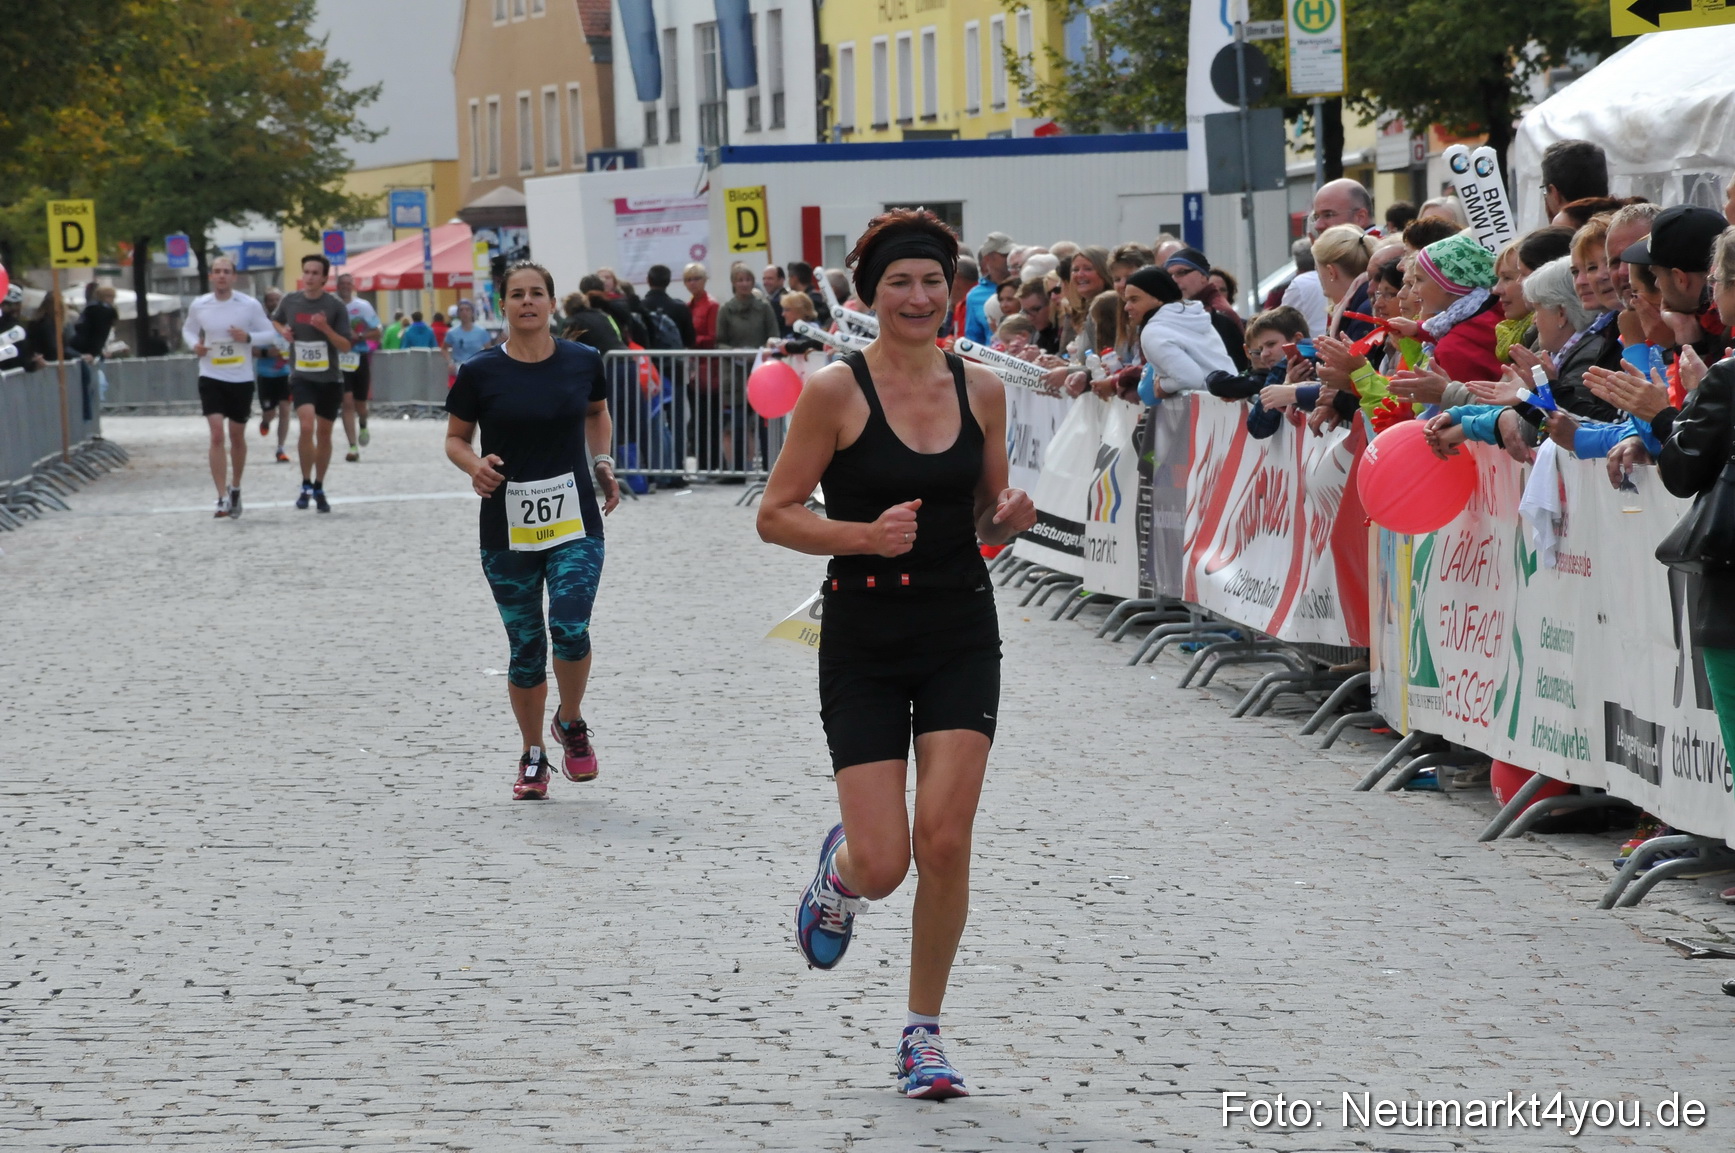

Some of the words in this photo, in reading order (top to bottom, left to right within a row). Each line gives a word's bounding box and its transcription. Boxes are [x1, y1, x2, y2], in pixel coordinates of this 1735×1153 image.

[53, 203, 88, 216] Block
[728, 190, 763, 202] Block
[1461, 183, 1491, 229] BMW
[1483, 187, 1510, 234] BMW
[61, 221, 84, 253] D
[736, 206, 759, 239] D
[531, 483, 565, 495] Neumarkt
[521, 494, 565, 525] 267
[536, 529, 555, 541] Ulla
